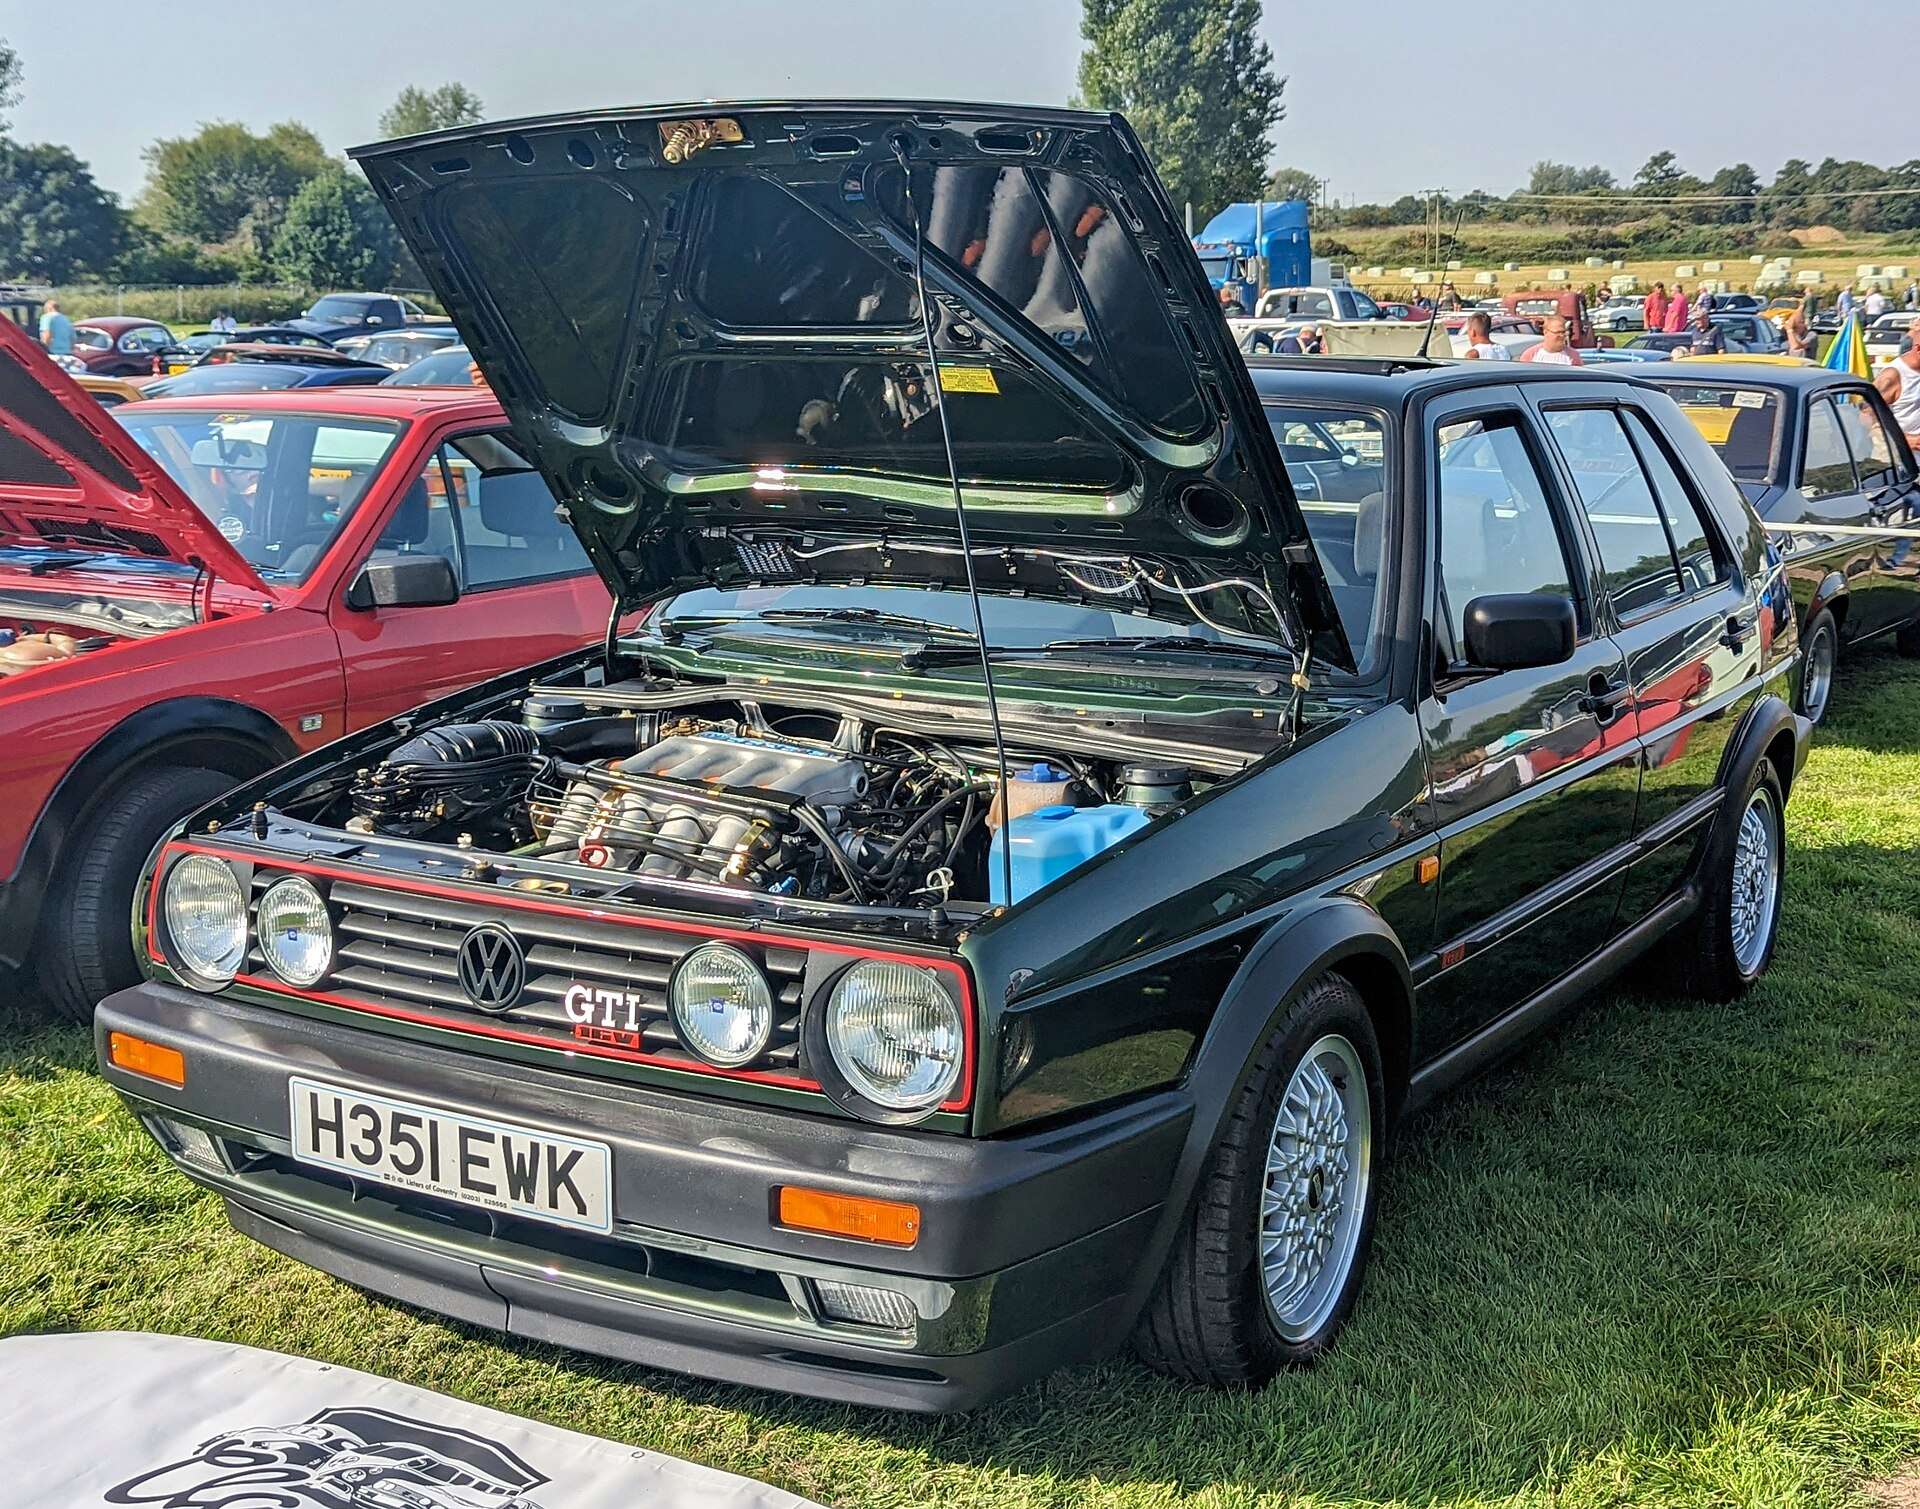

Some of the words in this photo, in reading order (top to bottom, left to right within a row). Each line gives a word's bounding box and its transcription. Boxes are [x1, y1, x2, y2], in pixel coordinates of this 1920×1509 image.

[565, 984, 641, 1031] GTI
[309, 1092, 440, 1183] H351
[458, 1125, 588, 1216] EWK
[432, 1185, 458, 1198] Coventry
